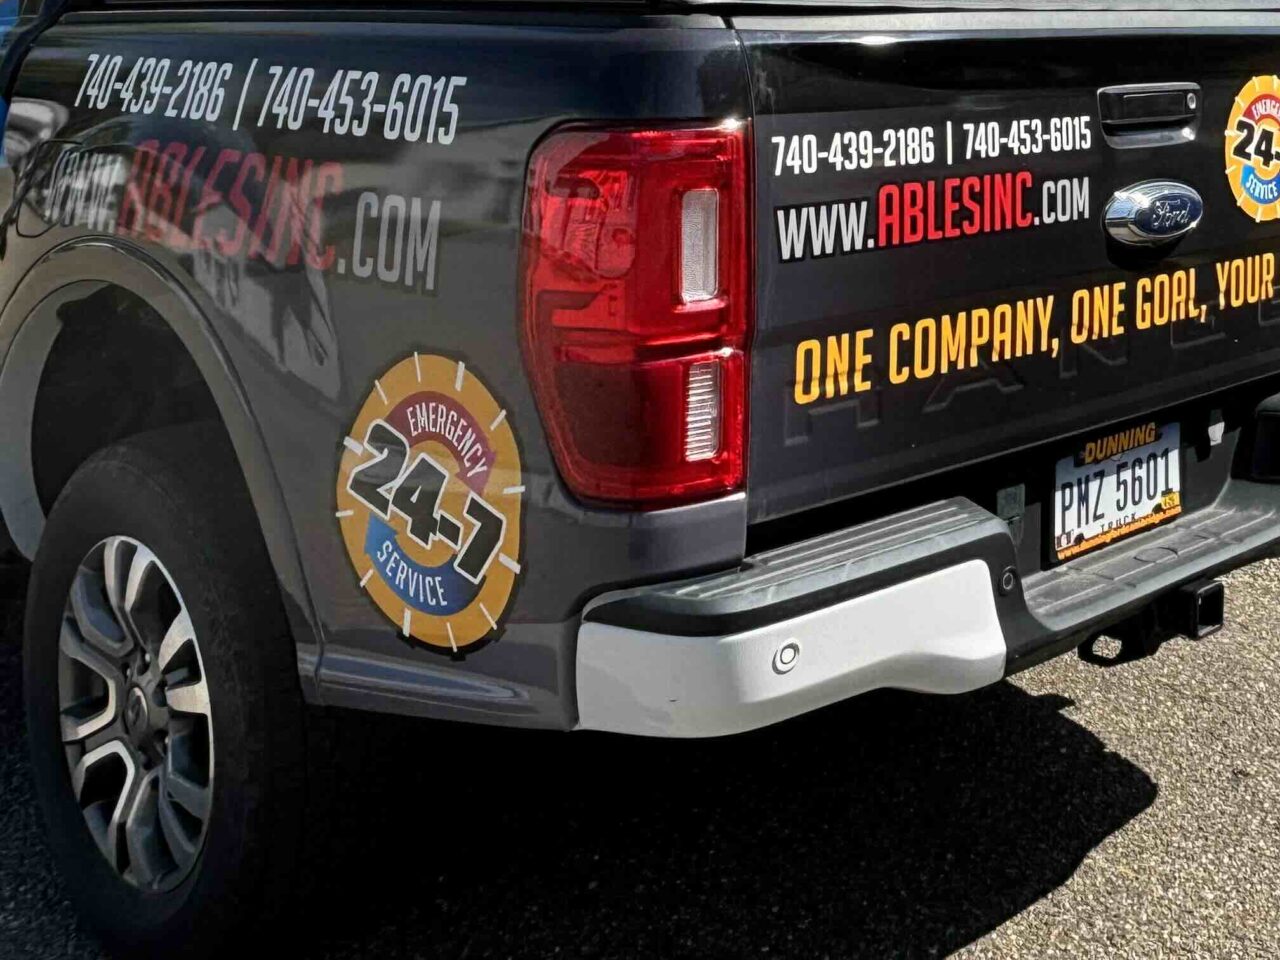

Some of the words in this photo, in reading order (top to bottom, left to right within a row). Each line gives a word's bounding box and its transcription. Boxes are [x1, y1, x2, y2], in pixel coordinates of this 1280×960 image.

[74, 54, 233, 122] 740-439-2186
[258, 66, 467, 145] 740-453-6015
[771, 126, 935, 176] 740-439-2186
[963, 115, 1092, 160] 740-453-6015
[777, 171, 1090, 260] WWW.ABLESINC.COM
[1151, 198, 1191, 229] Ford
[1245, 174, 1279, 199] SERVICE
[793, 328, 874, 405] ONE
[889, 294, 1060, 384] COMPANY,
[1071, 282, 1125, 344] ONE
[1136, 267, 1207, 330] GOAL,
[1215, 254, 1275, 311] YOUR
[407, 401, 488, 478] EMERGENCY
[1084, 422, 1156, 464] DUNNING
[347, 418, 507, 585] 24-7
[1061, 469, 1106, 534] PMZ
[1115, 447, 1173, 512] 5601
[376, 540, 449, 606] SERVICE
